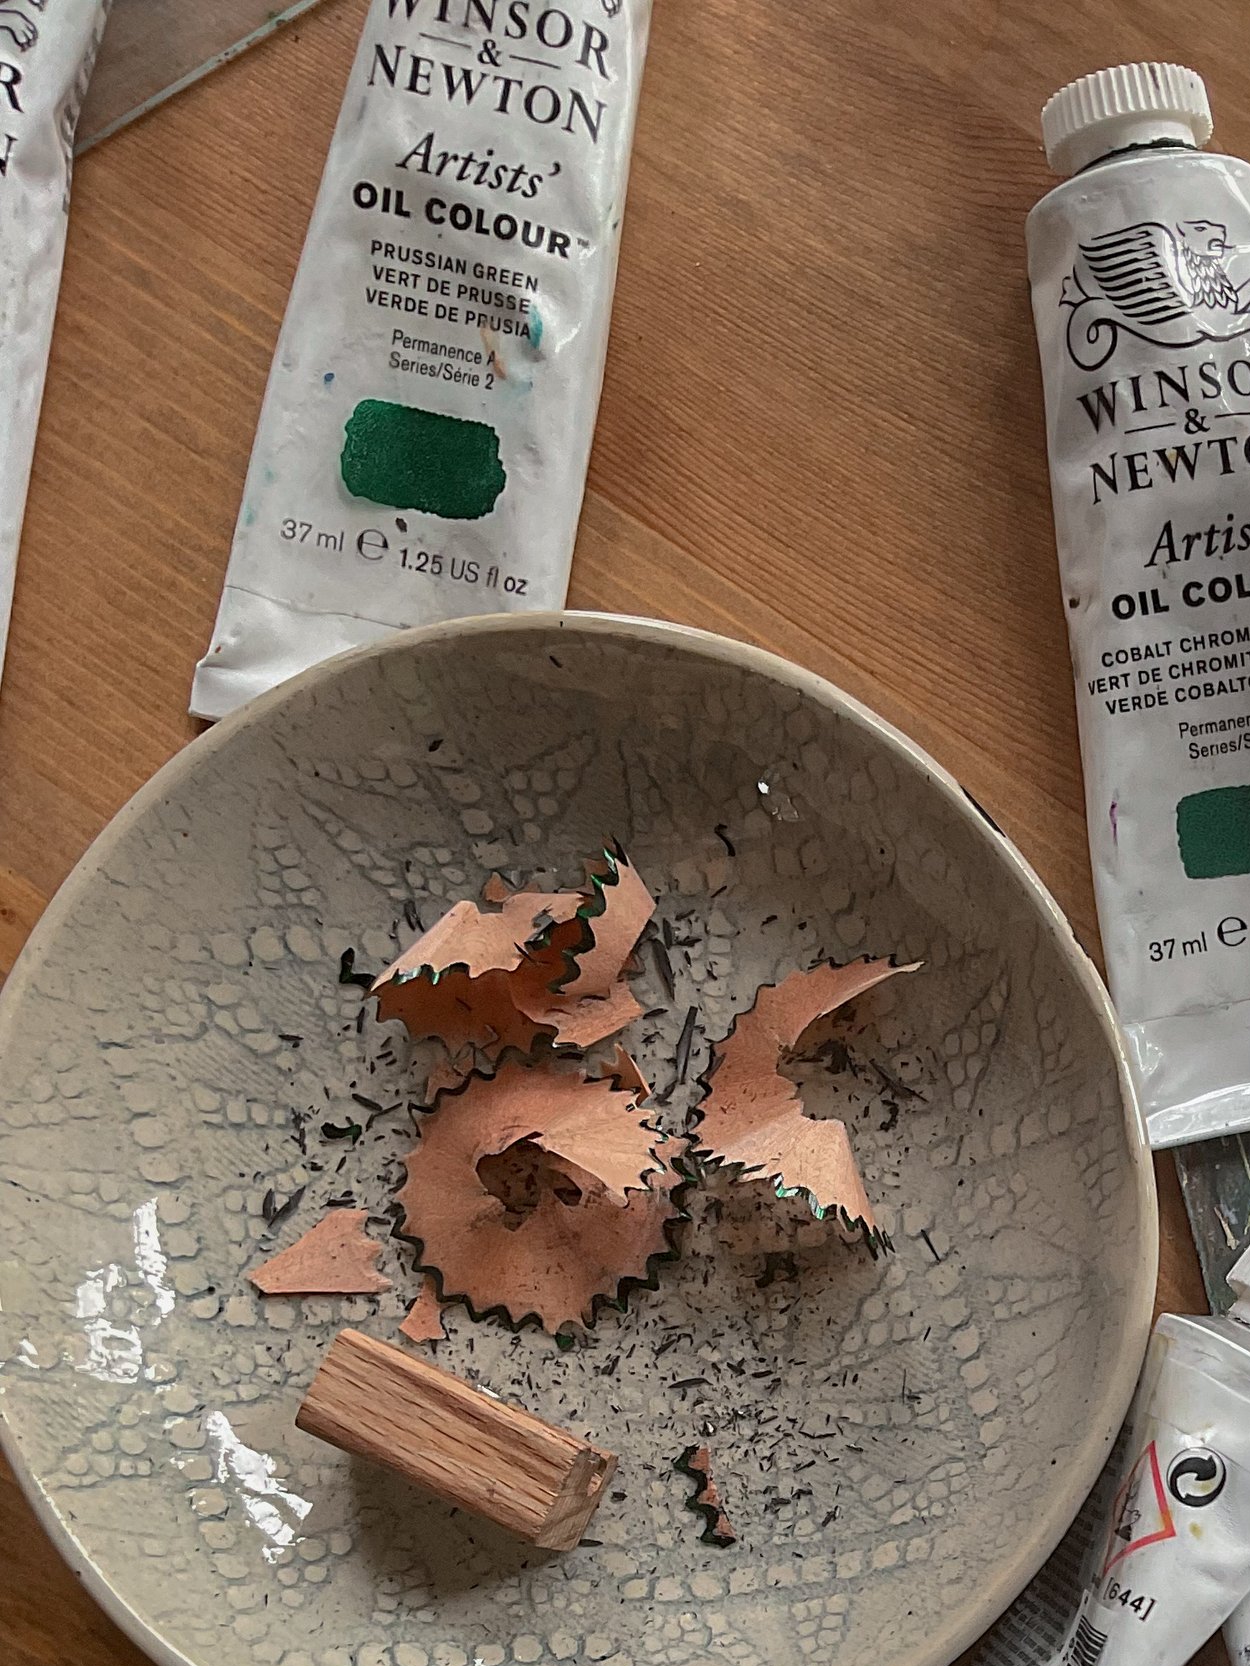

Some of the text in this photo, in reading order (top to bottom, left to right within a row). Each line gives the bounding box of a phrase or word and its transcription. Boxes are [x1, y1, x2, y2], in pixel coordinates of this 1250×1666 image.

[388, 0, 610, 80] WINSOR
[477, 39, 502, 67] &
[367, 44, 607, 144] NEWTON
[395, 132, 563, 200] Artists'
[352, 181, 411, 220] OIL
[370, 240, 539, 293] PRUSSIAN GREEN
[372, 264, 531, 315] VERT DE PRUSSE
[365, 287, 531, 341] VERDE DE PRUSIA
[391, 328, 483, 366] Permanence
[484, 372, 495, 390] 2
[1184, 407, 1211, 436] &
[399, 547, 528, 597] 1.25 US fl oz
[1110, 589, 1169, 621] OIL
[1100, 639, 1173, 668] COBALT
[1087, 667, 1132, 696] VERT
[1136, 663, 1164, 688] DE
[1104, 689, 1168, 716] VERDE
